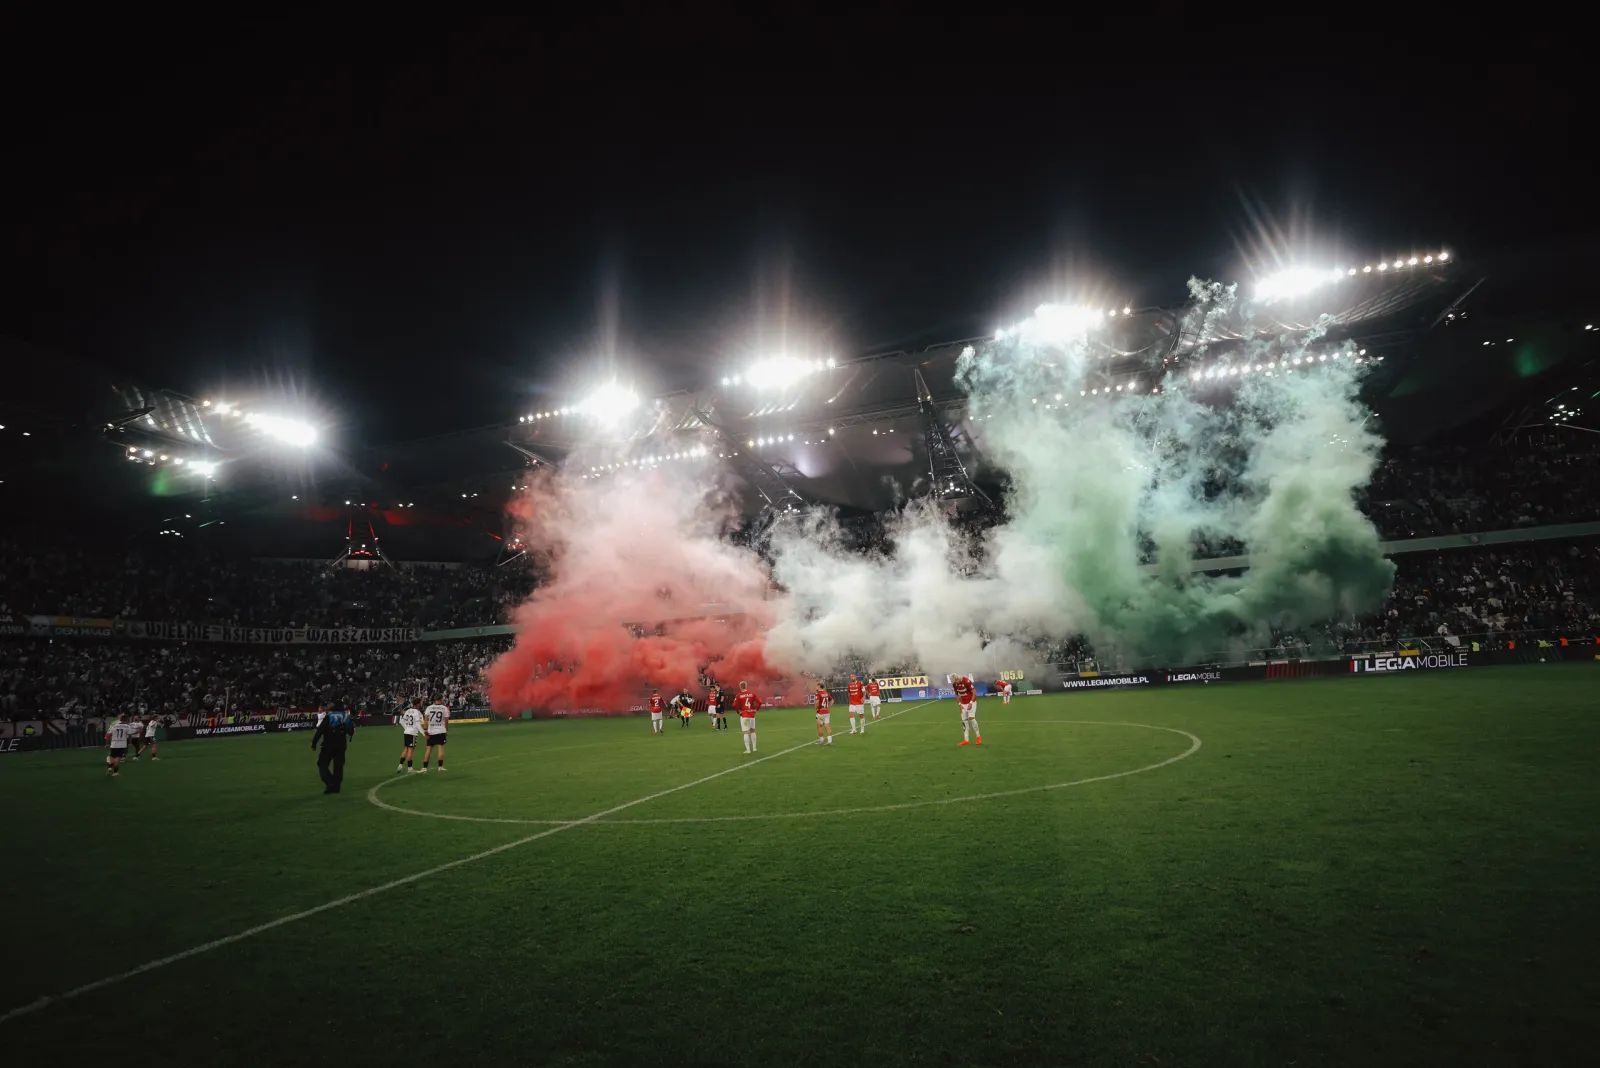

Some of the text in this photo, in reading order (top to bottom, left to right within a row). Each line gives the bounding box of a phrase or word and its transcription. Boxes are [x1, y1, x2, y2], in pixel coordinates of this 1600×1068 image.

[145, 622, 210, 640] WIELKIE
[306, 628, 413, 643] WARSZAWSKIE
[1364, 653, 1468, 672] LEGIAMOBILE
[999, 670, 1024, 681] 105.0
[1172, 672, 1220, 682] LEGIAMOBILE
[878, 677, 926, 687] ORTUNA
[1063, 676, 1149, 688] WWW.LEGIAMOBILE.PL
[654, 699, 660, 707] 2
[744, 697, 751, 709] 4
[429, 711, 443, 723] 79
